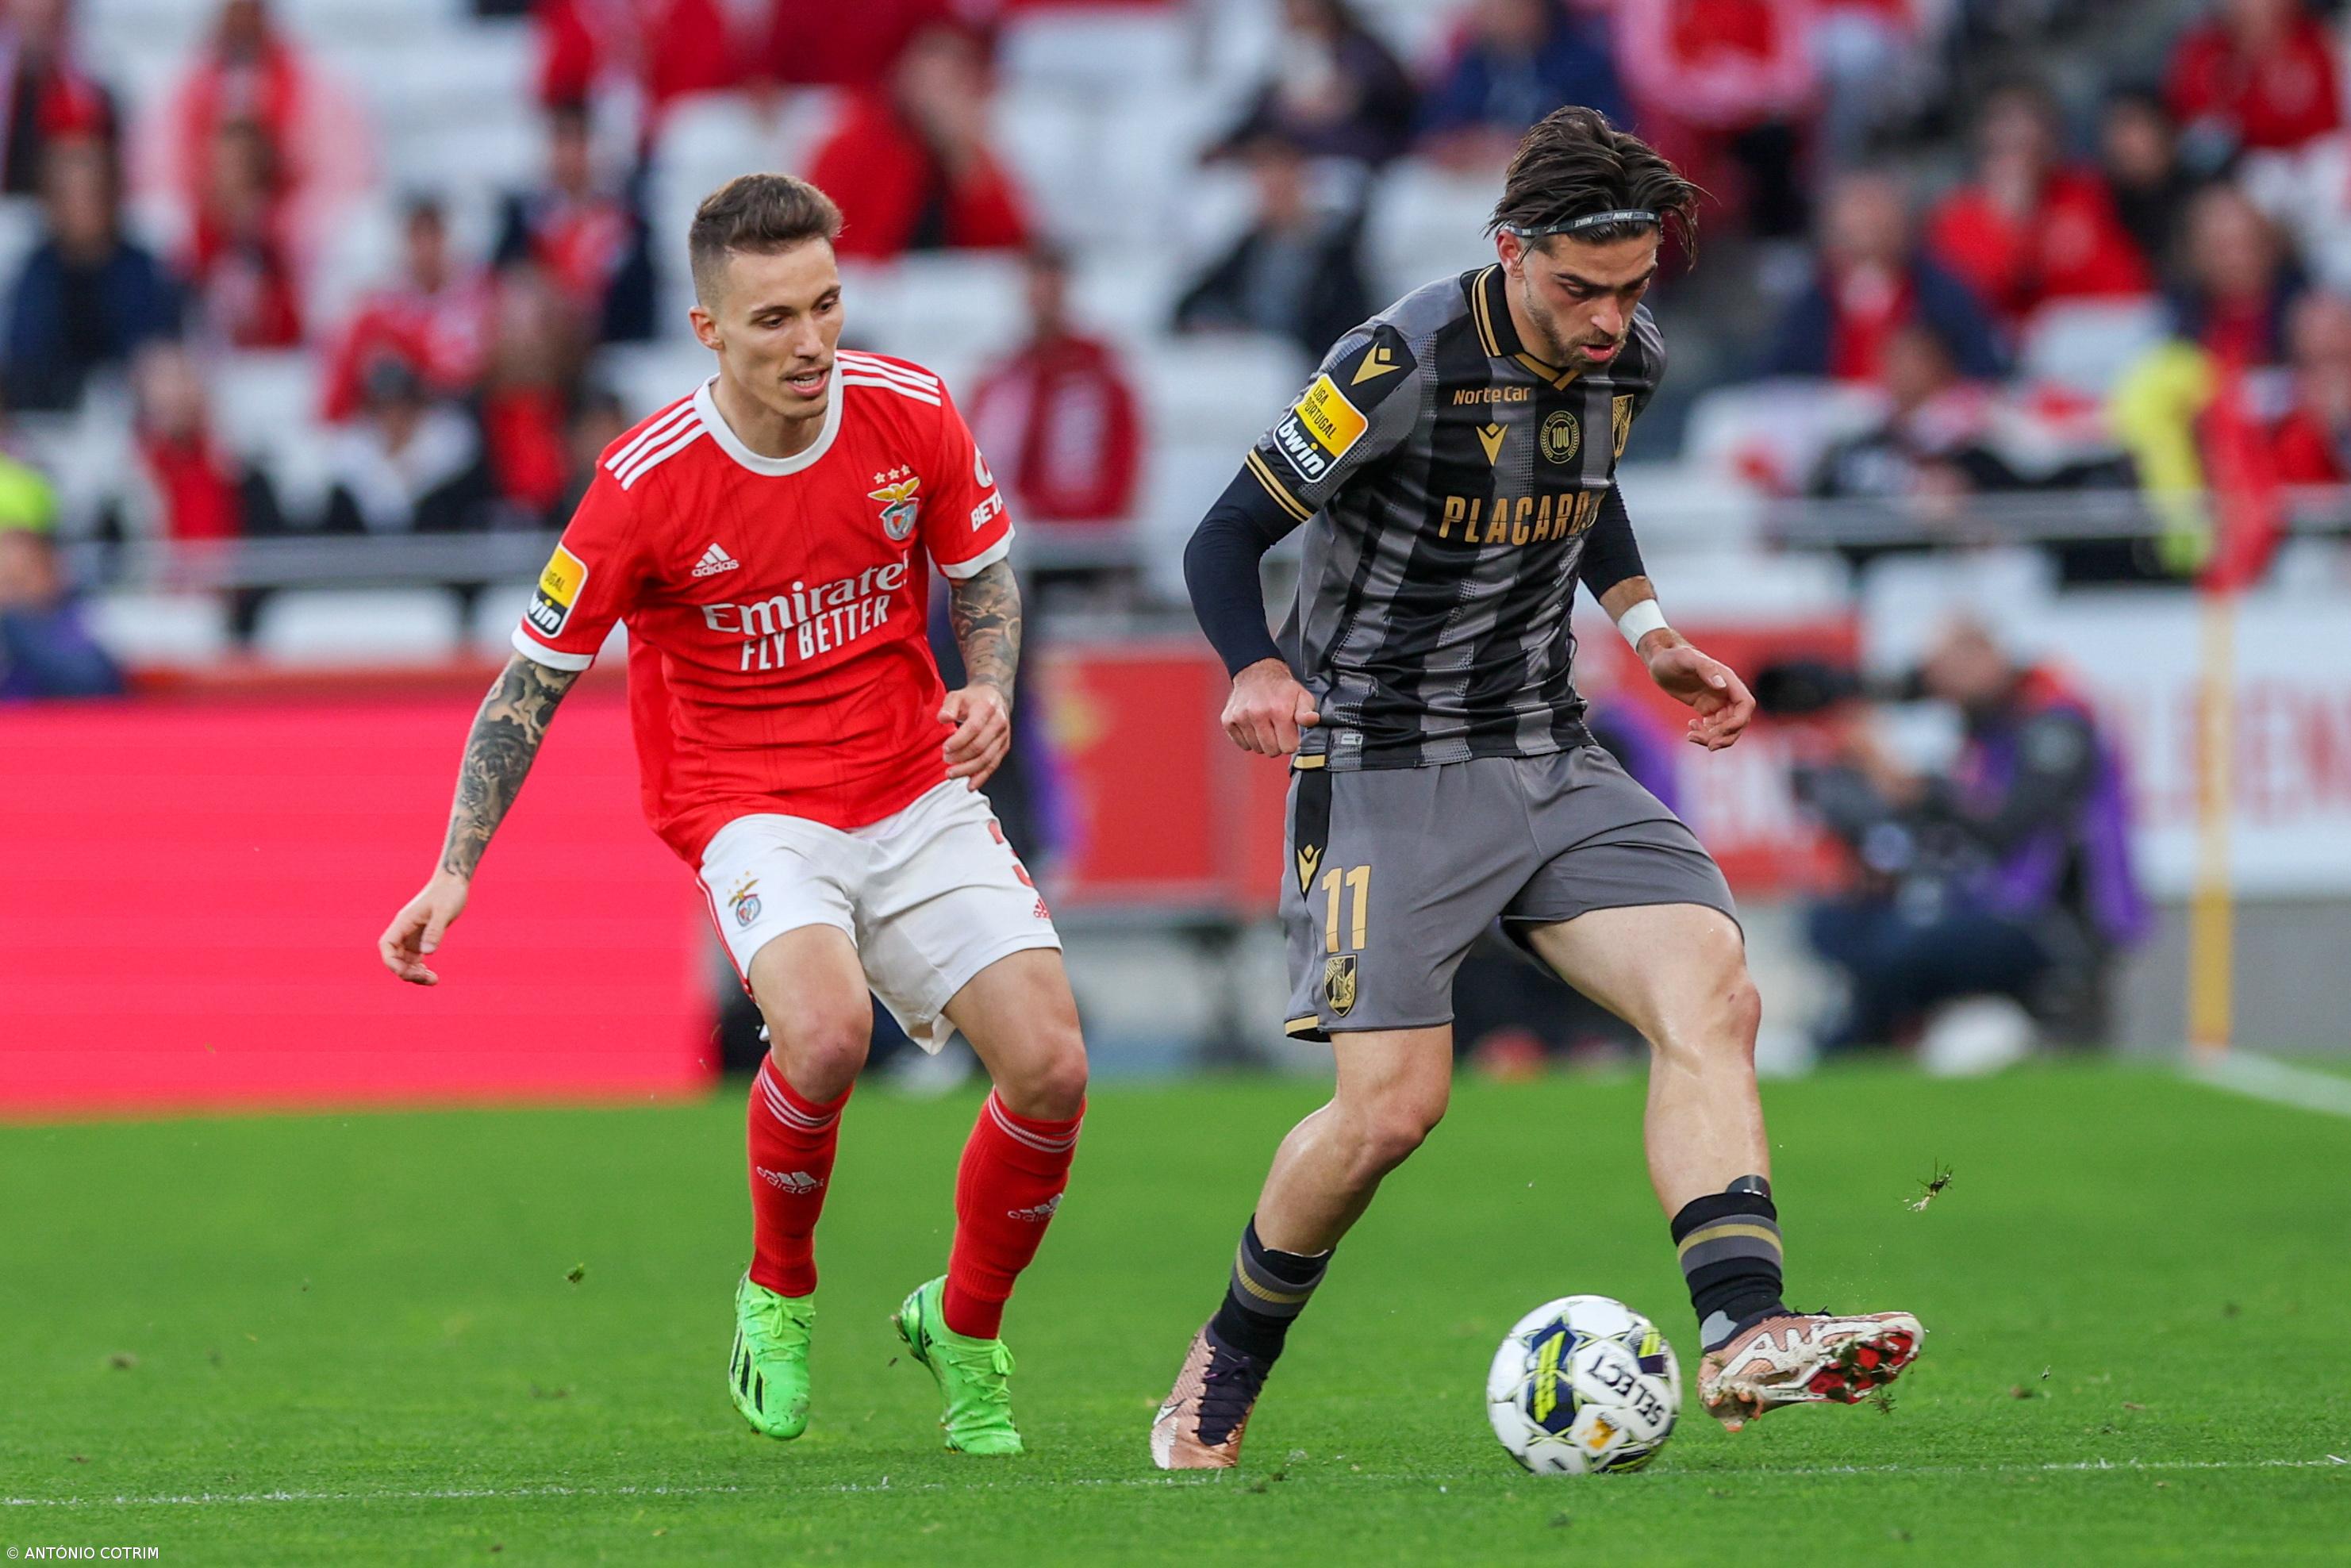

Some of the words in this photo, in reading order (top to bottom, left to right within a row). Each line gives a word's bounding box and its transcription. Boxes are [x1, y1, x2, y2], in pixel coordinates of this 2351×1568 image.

[1304, 396, 1338, 440] PORTUGAL
[1312, 384, 1330, 407] LIGA
[1278, 417, 1326, 475] bwin
[1552, 426, 1569, 449] 100
[691, 559, 739, 578] adidas
[740, 632, 786, 671] FLY
[797, 594, 890, 660] BETTER
[1321, 864, 1371, 954] 11
[1586, 1355, 1665, 1426] SELECT
